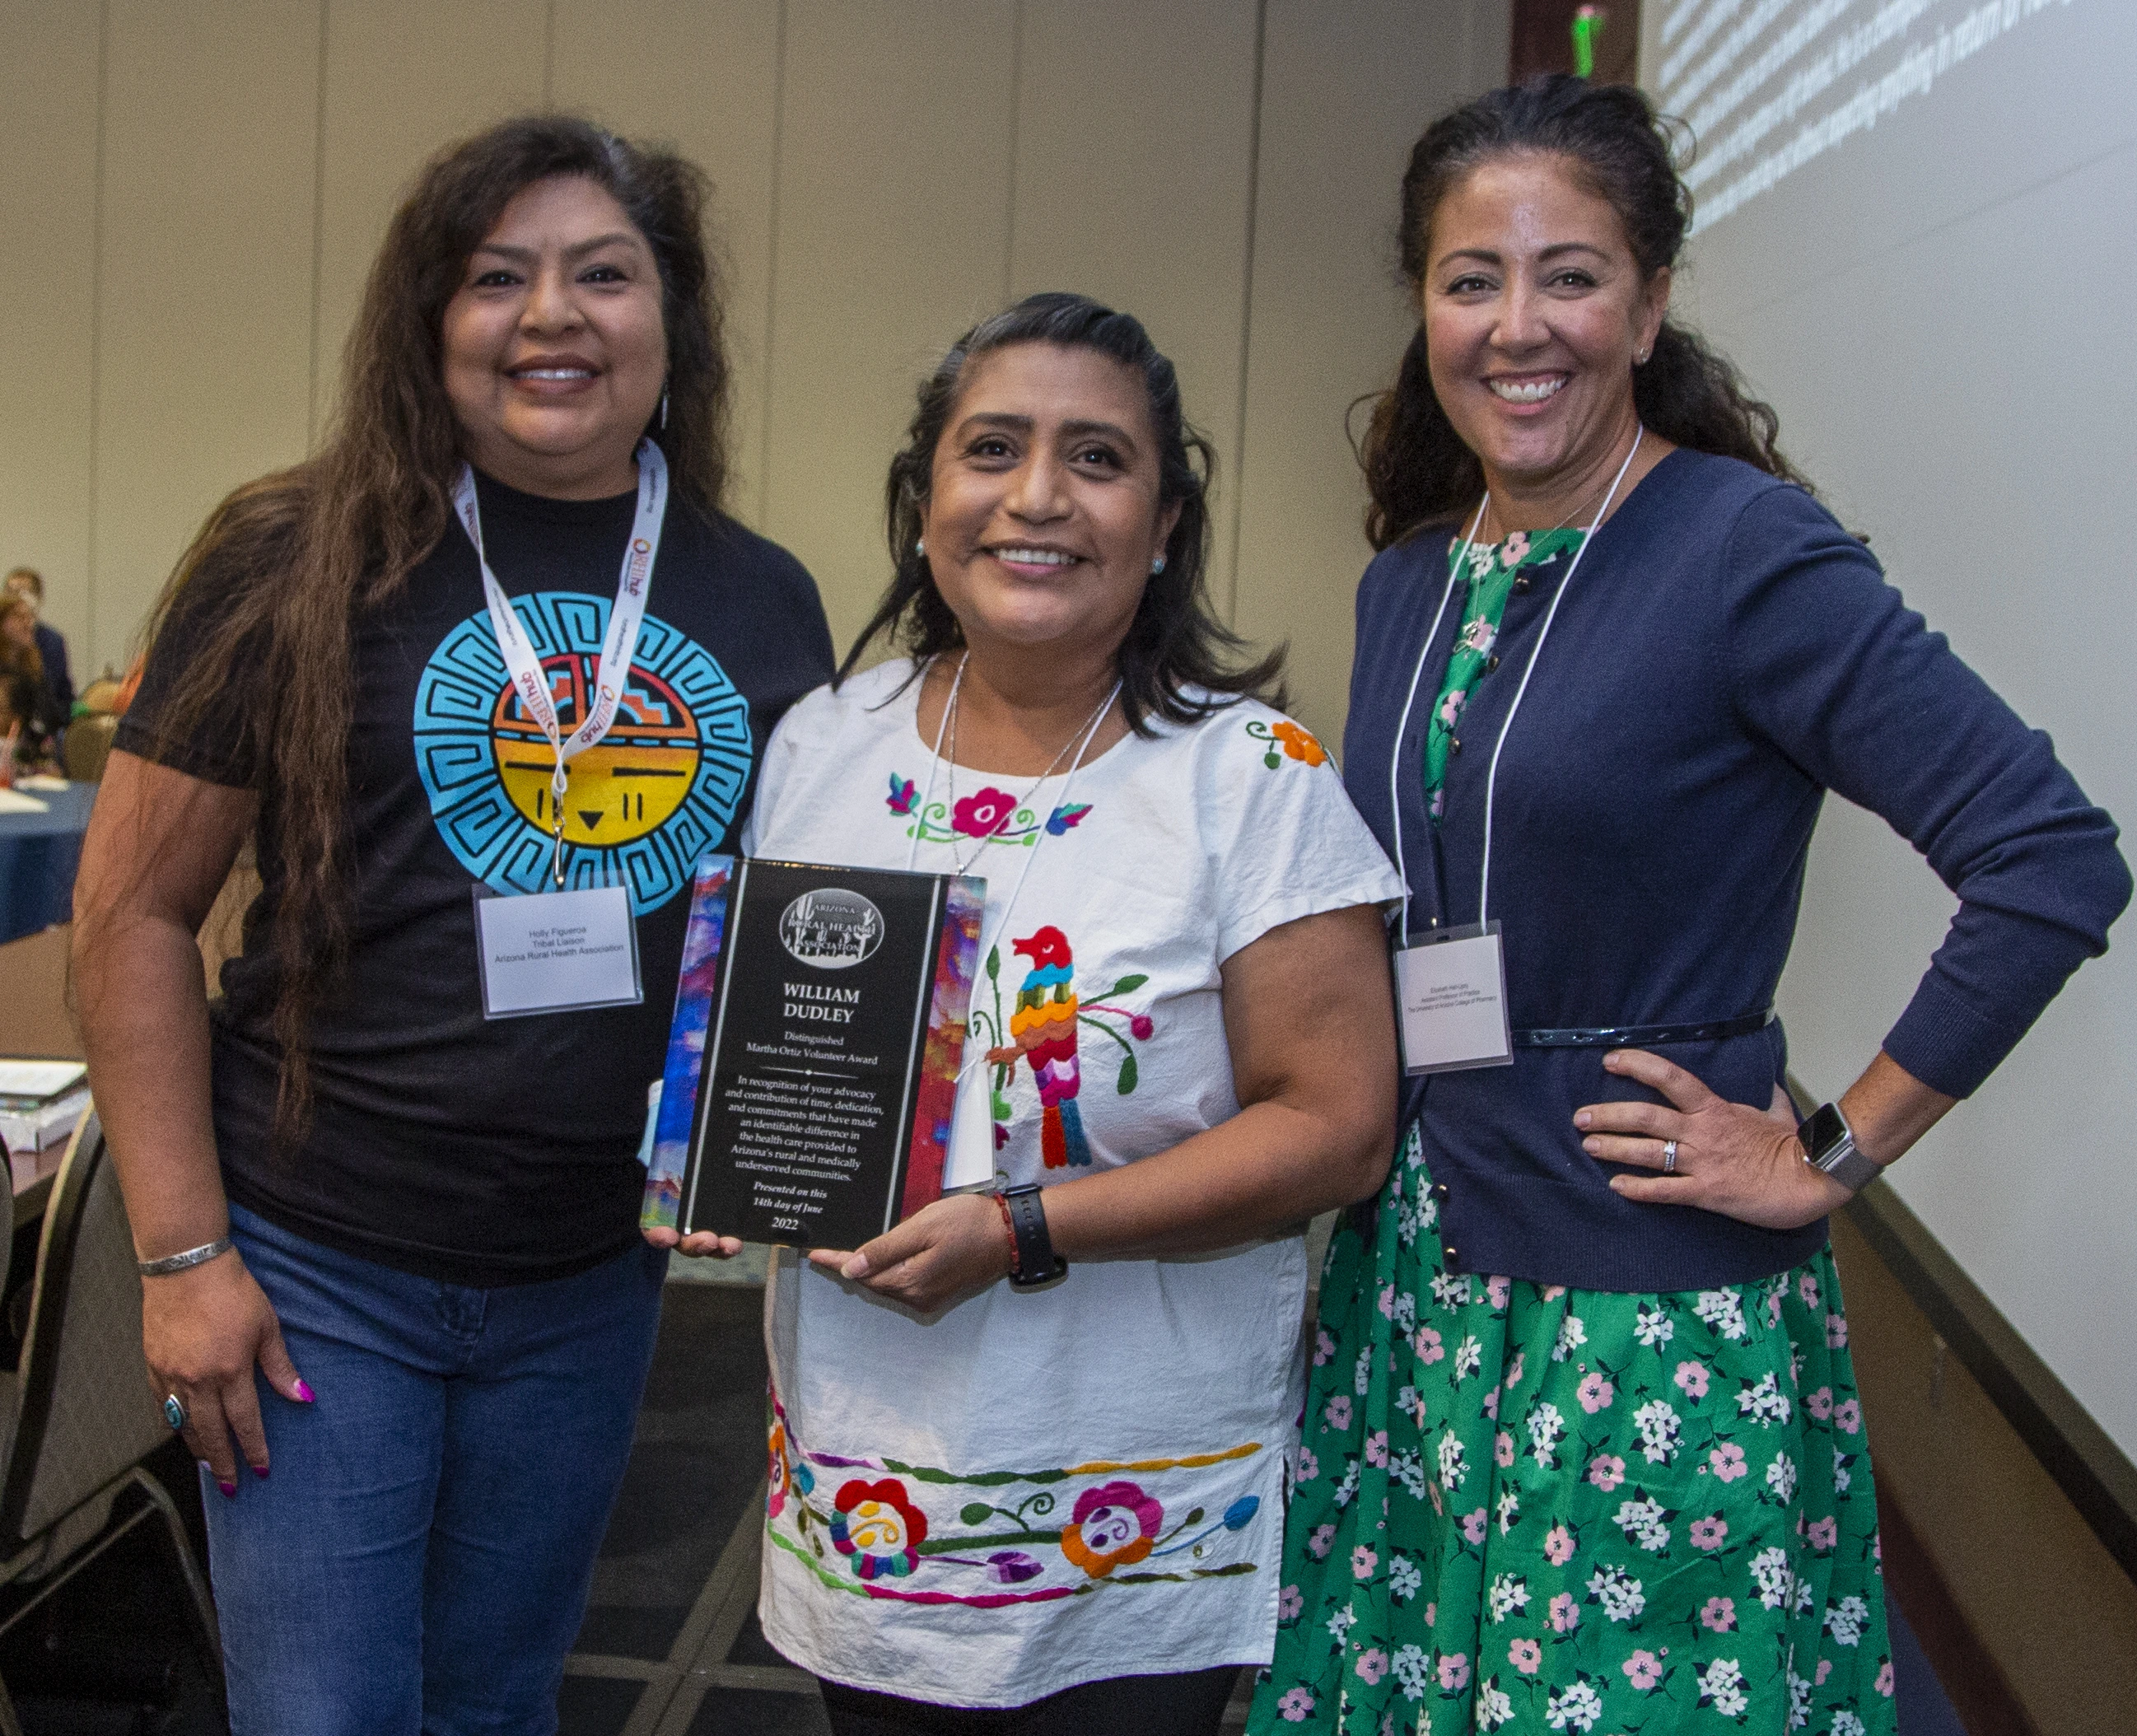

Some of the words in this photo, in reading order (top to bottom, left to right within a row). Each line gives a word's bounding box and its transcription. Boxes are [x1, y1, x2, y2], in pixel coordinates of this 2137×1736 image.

[815, 904, 856, 914] ARIZONA
[530, 930, 549, 939] Holly
[551, 926, 586, 937] Figueroa
[557, 937, 585, 946] Liaison
[495, 954, 525, 963] Arizona
[527, 951, 549, 960] Rural
[551, 949, 577, 958] Health
[579, 944, 624, 955] Association
[784, 982, 861, 1003] WILLIAM
[784, 1003, 854, 1023] DUDLEY
[785, 1031, 844, 1046] Distinguished
[746, 1042, 777, 1054] Martha
[779, 1046, 801, 1057] Ortiz
[804, 1048, 846, 1062] Volunteer
[847, 1054, 878, 1065] Award
[738, 1076, 747, 1085] In
[749, 1078, 798, 1090] recognition
[800, 1083, 810, 1091] of
[810, 1085, 832, 1095] your
[834, 1087, 876, 1102] advocacy
[725, 1090, 742, 1099] and
[744, 1092, 797, 1104] contribution
[800, 1097, 810, 1106] of
[811, 1099, 833, 1109] time,
[834, 1101, 884, 1115] dedication,
[728, 1104, 745, 1112] and
[747, 1106, 807, 1119] commitments
[809, 1113, 826, 1122] that
[828, 1114, 850, 1124] have
[851, 1118, 877, 1128] made
[740, 1118, 751, 1127] an
[754, 1119, 803, 1133] identifiable
[805, 1125, 849, 1138] difference
[851, 1131, 860, 1140] in
[740, 1132, 754, 1141] the
[754, 1133, 782, 1145] health
[784, 1138, 803, 1147] care
[804, 1139, 845, 1153] provided
[847, 1146, 857, 1154] to
[731, 1145, 773, 1157] Arizona's
[775, 1148, 796, 1160] rural
[798, 1152, 815, 1163] and
[817, 1156, 861, 1171] medically
[735, 1160, 791, 1174] underserved
[791, 1167, 852, 1182] communities.
[754, 1181, 796, 1195] Presented
[796, 1188, 808, 1196] on
[810, 1187, 827, 1198] this
[754, 1197, 772, 1207] 14th
[774, 1200, 791, 1211] day
[791, 1203, 803, 1216] of
[802, 1204, 823, 1214] June
[772, 1217, 799, 1230] 2022
